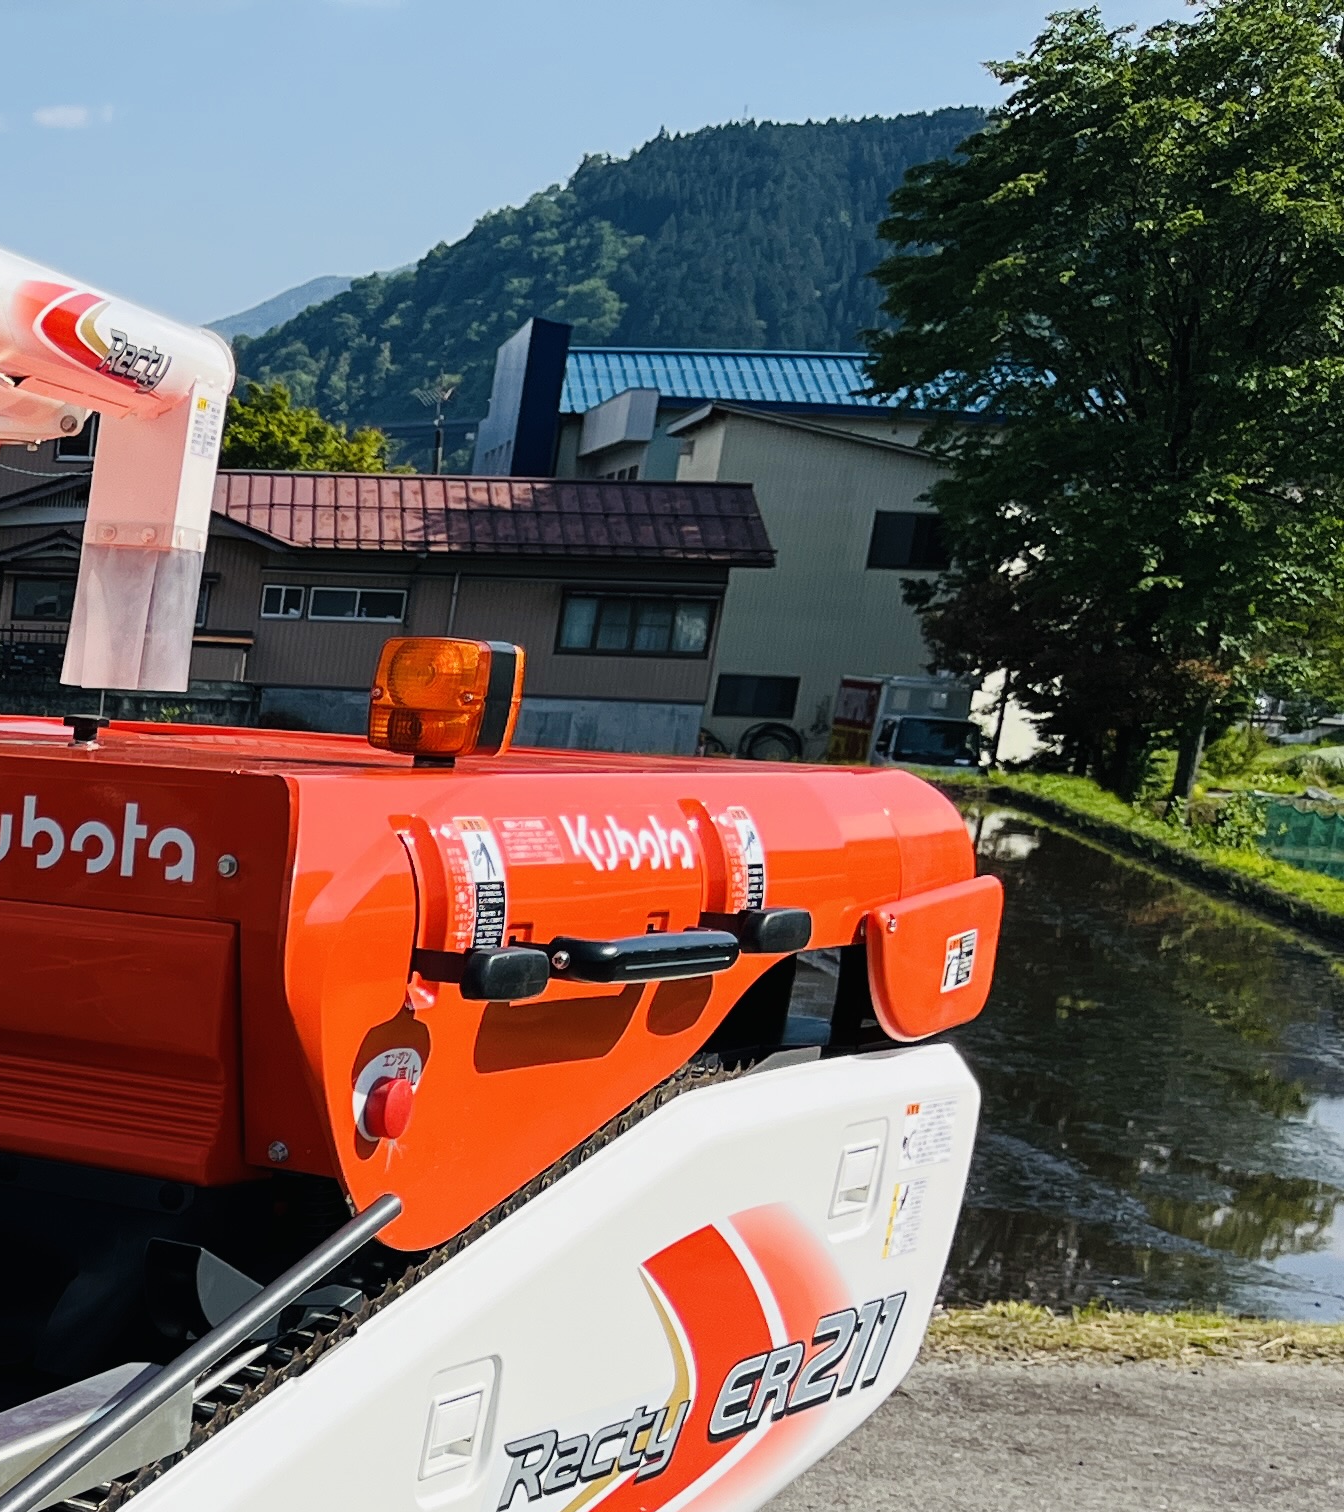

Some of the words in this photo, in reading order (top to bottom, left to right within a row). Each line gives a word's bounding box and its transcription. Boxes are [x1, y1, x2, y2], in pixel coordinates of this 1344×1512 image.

[96, 328, 172, 394] Racty
[559, 815, 695, 871] Kubota
[382, 1051, 413, 1068] エンジン
[496, 1400, 691, 1512] Racty
[707, 1291, 907, 1443] ER211
